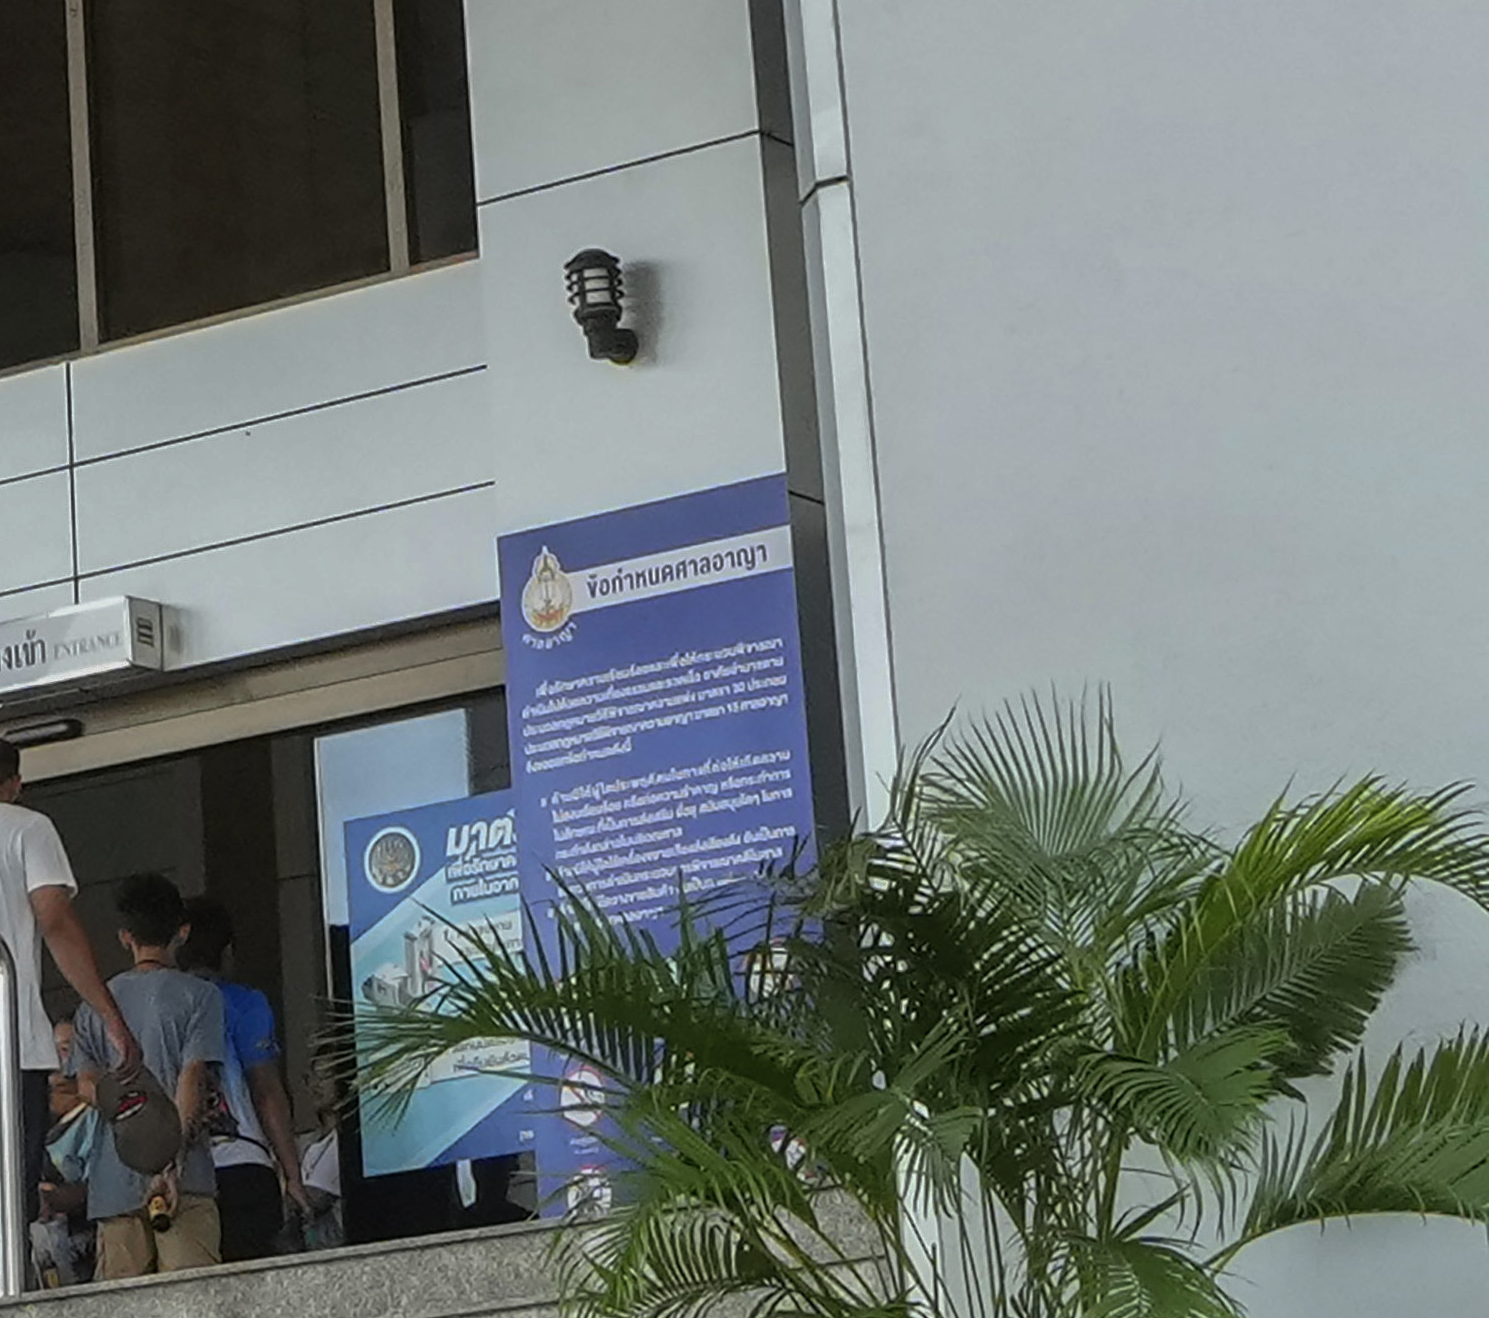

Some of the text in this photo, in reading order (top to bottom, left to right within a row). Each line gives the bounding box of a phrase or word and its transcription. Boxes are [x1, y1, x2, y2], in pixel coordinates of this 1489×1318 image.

[586, 543, 768, 599] ข้อกำหนดศาลอาญา
[54, 634, 121, 660] ENTRANCE
[446, 808, 518, 861] มาต
